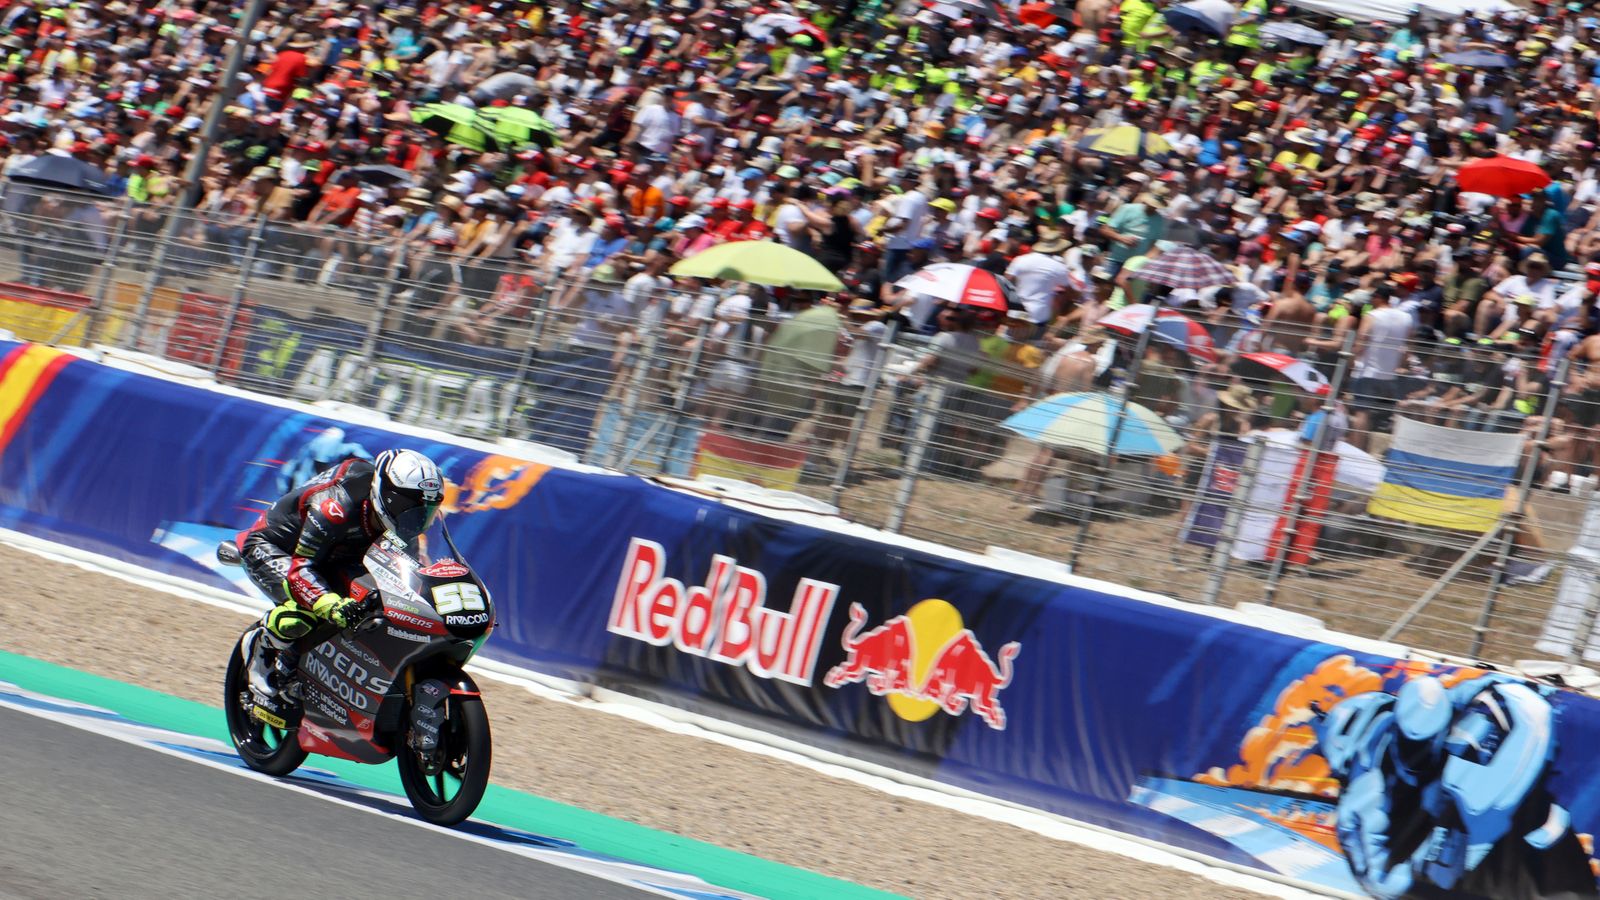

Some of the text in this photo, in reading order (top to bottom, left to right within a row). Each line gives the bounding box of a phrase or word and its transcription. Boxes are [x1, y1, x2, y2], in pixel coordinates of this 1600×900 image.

[431, 582, 485, 615] 55
[606, 537, 841, 687] Red Bull
[386, 610, 434, 629] SNIPERS
[446, 612, 489, 625] RIVACOLD
[305, 652, 368, 710] RIVACOLD
